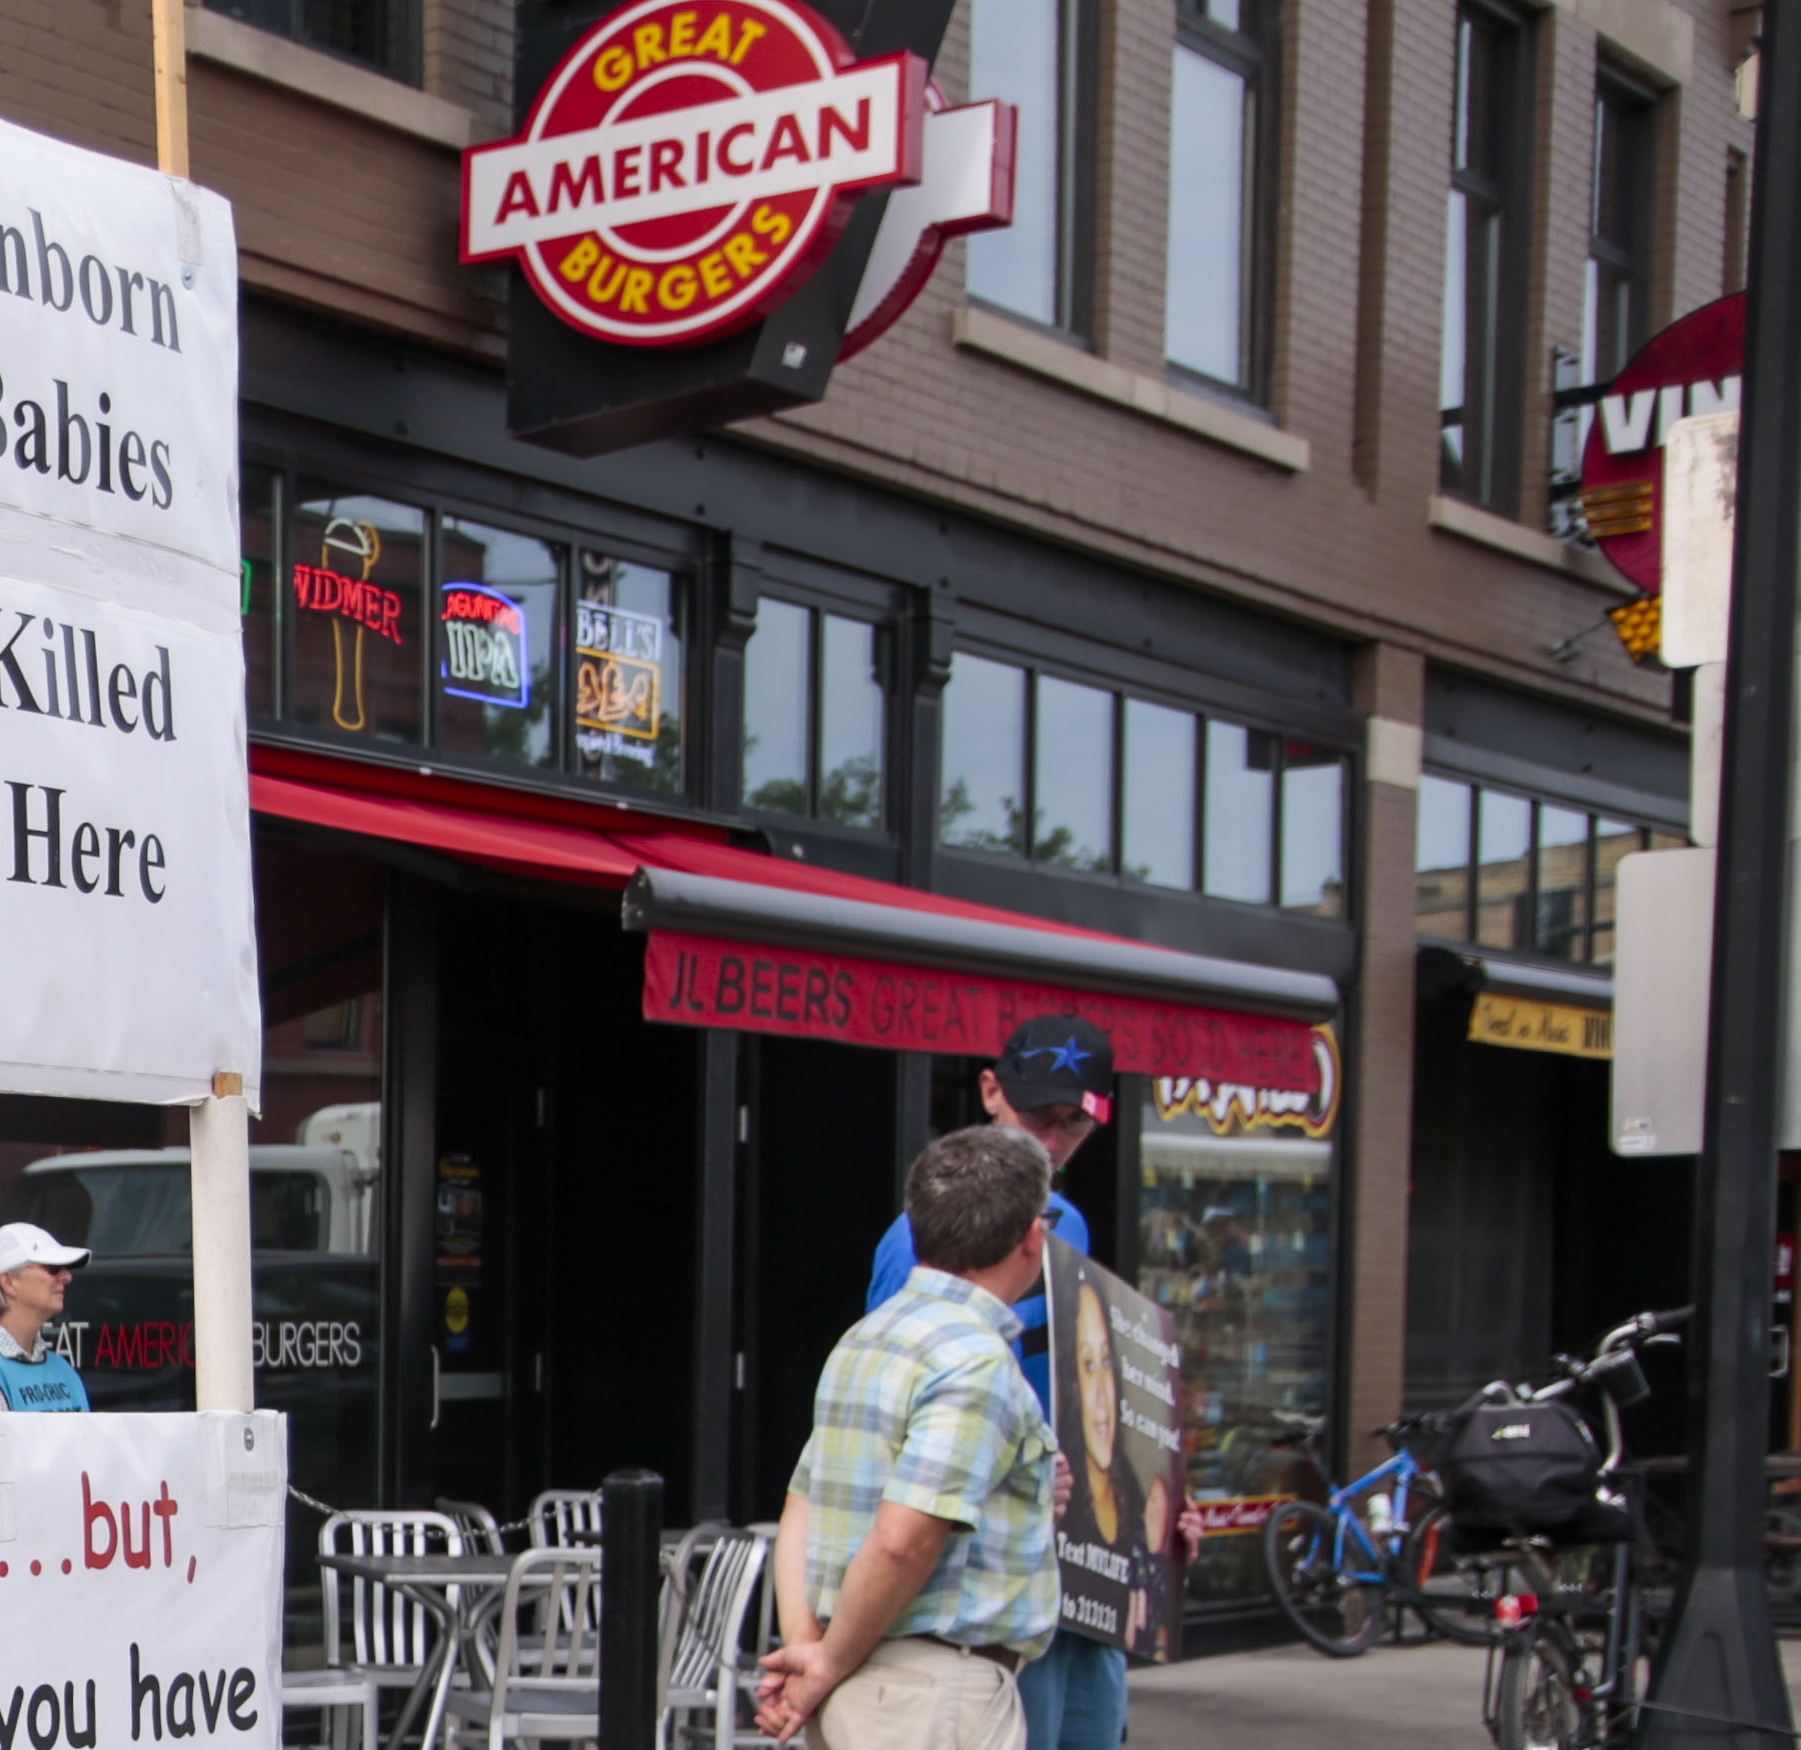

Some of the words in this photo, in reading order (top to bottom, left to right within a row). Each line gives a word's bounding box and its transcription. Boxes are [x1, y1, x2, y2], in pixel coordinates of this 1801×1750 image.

[593, 11, 767, 92] GREAT
[493, 97, 872, 227] AMERICAN
[558, 203, 793, 315] BURGERS
[441, 590, 521, 637] AGUNITAS
[447, 619, 521, 689] IPA
[3, 780, 167, 905] Here
[713, 955, 855, 1028] BEERS
[870, 975, 984, 1043] GREAT
[94, 1321, 196, 1369] AMERIC
[253, 1321, 361, 1369] BURGERS
[129, 1641, 259, 1742] have
